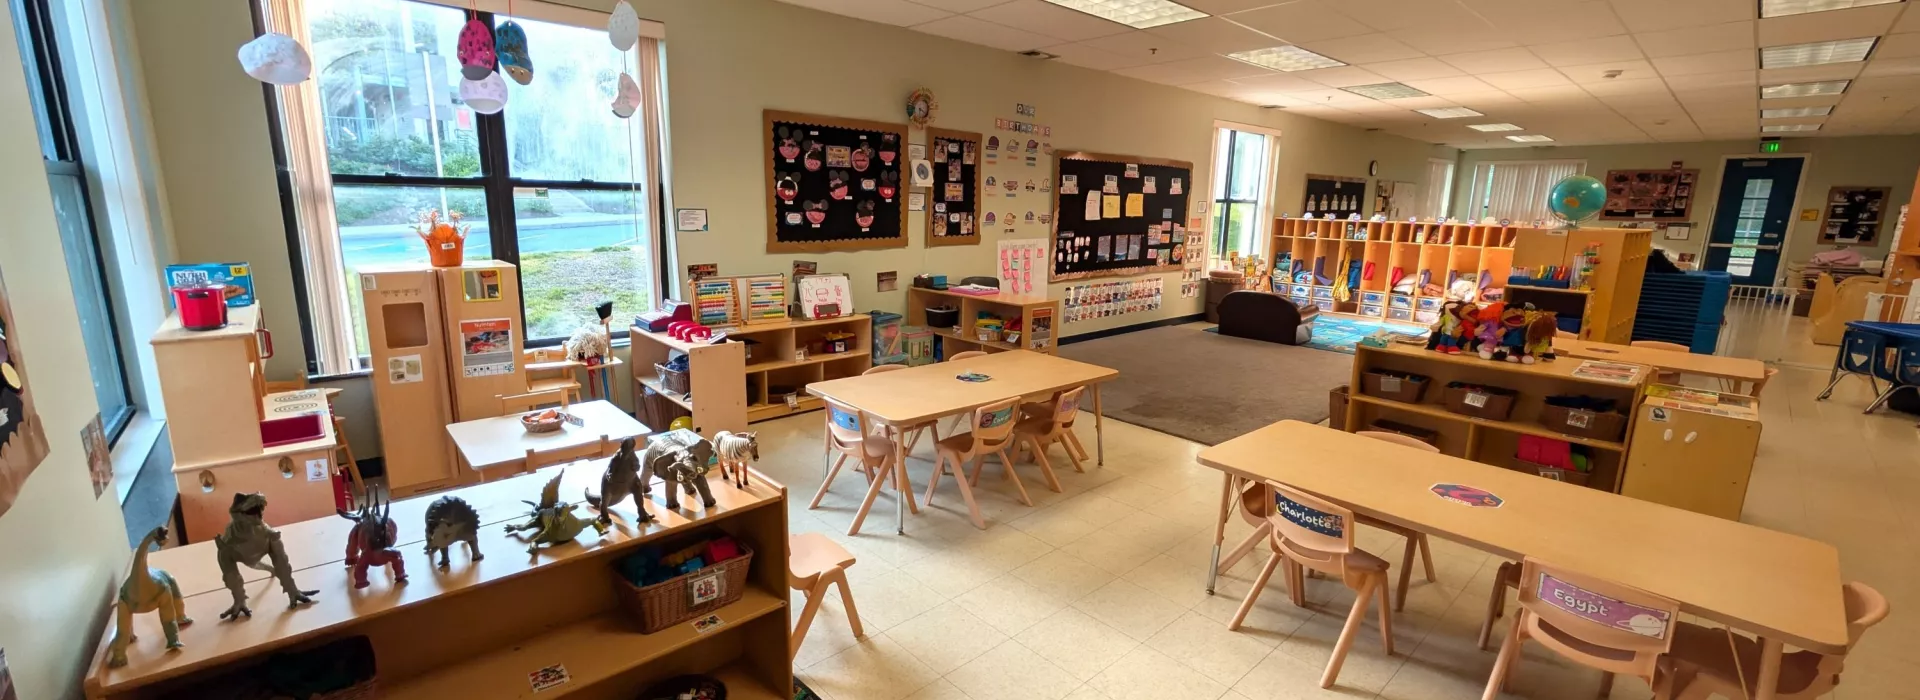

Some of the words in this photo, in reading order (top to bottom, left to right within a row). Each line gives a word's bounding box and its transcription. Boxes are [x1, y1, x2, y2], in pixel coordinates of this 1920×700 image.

[996, 118, 1050, 136] BIRTHDAYS
[1279, 501, 1331, 529] Charlotte
[1553, 587, 1609, 617] Egypt
